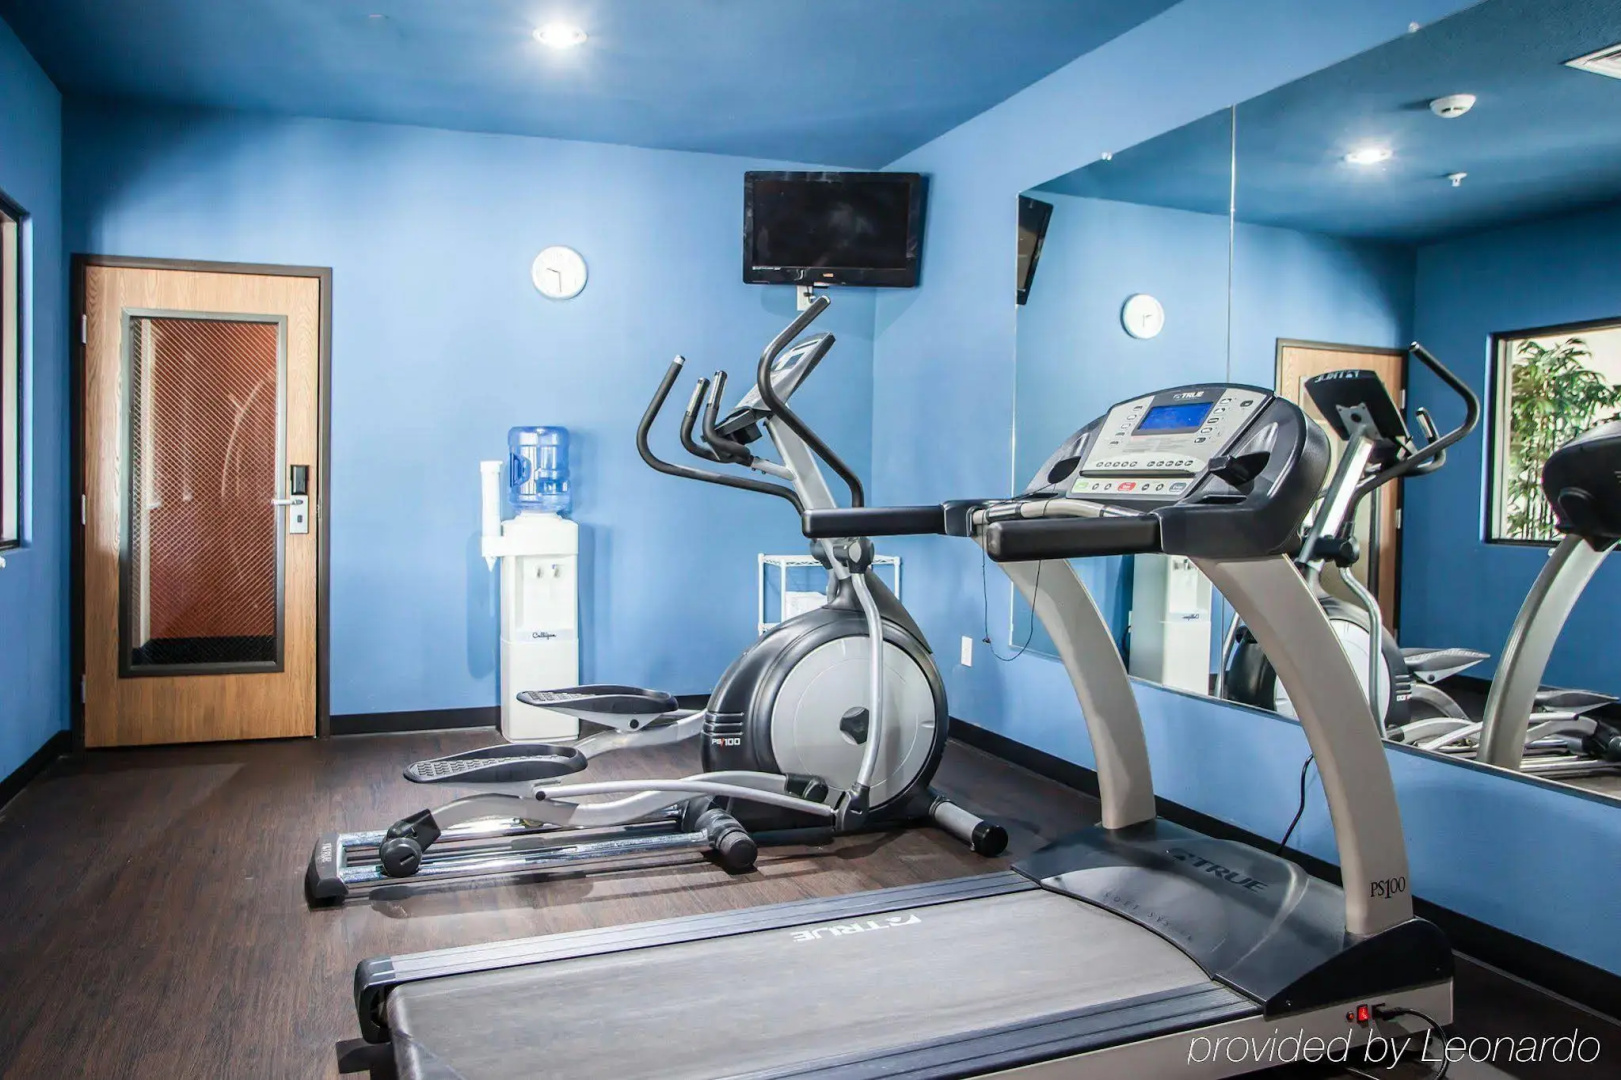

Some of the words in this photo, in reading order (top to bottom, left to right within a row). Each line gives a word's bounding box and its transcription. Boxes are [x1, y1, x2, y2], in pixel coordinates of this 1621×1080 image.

[1181, 391, 1205, 399] TRUE
[1192, 857, 1268, 893] TRUE
[1370, 876, 1406, 899] PS100
[790, 920, 890, 942] TRUE
